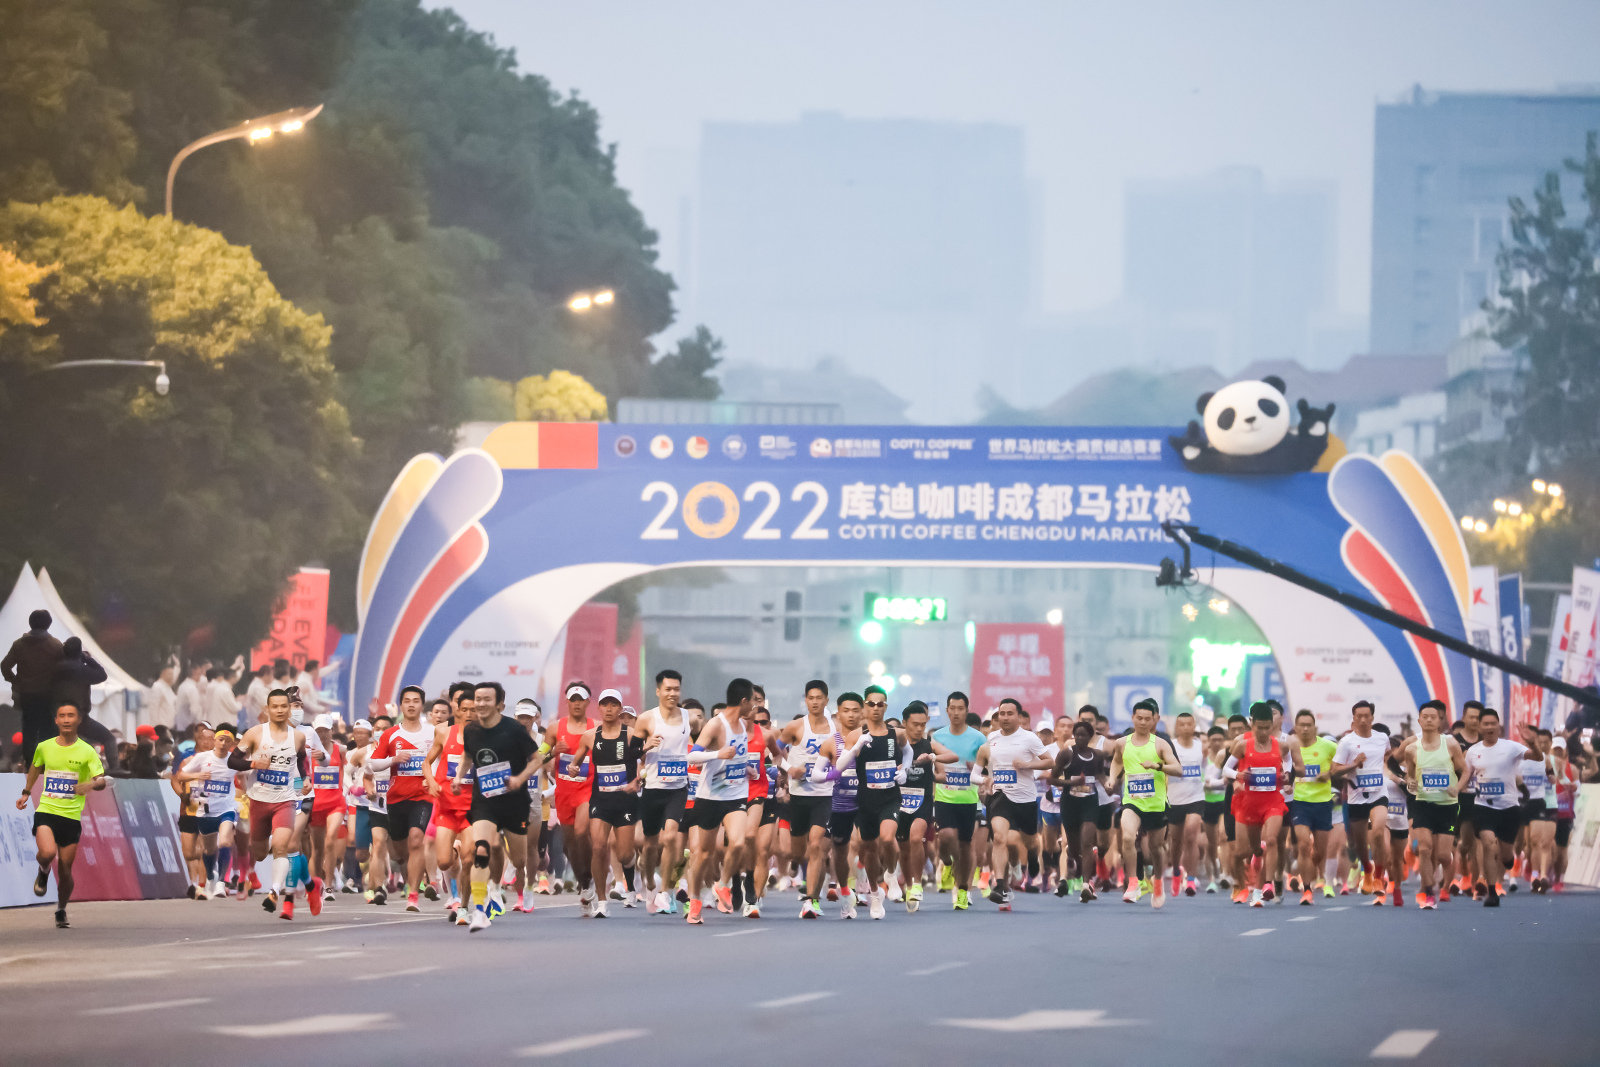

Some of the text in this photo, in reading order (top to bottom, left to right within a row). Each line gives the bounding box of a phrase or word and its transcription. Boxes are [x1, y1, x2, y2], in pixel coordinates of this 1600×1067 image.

[839, 481, 1192, 523] 库迪咖啡成都马拉松
[640, 481, 829, 539] 2022
[839, 524, 896, 540] COTTI
[901, 524, 976, 540] COFFEE
[981, 525, 1076, 541] CHENGDU
[660, 766, 686, 774] A0264
[260, 773, 286, 783] A0214
[603, 775, 620, 783] 010
[874, 771, 891, 780] 013
[47, 782, 75, 792] A1495
[481, 777, 506, 790] A031
[848, 778, 859, 786] 00
[901, 798, 921, 807] 0547
